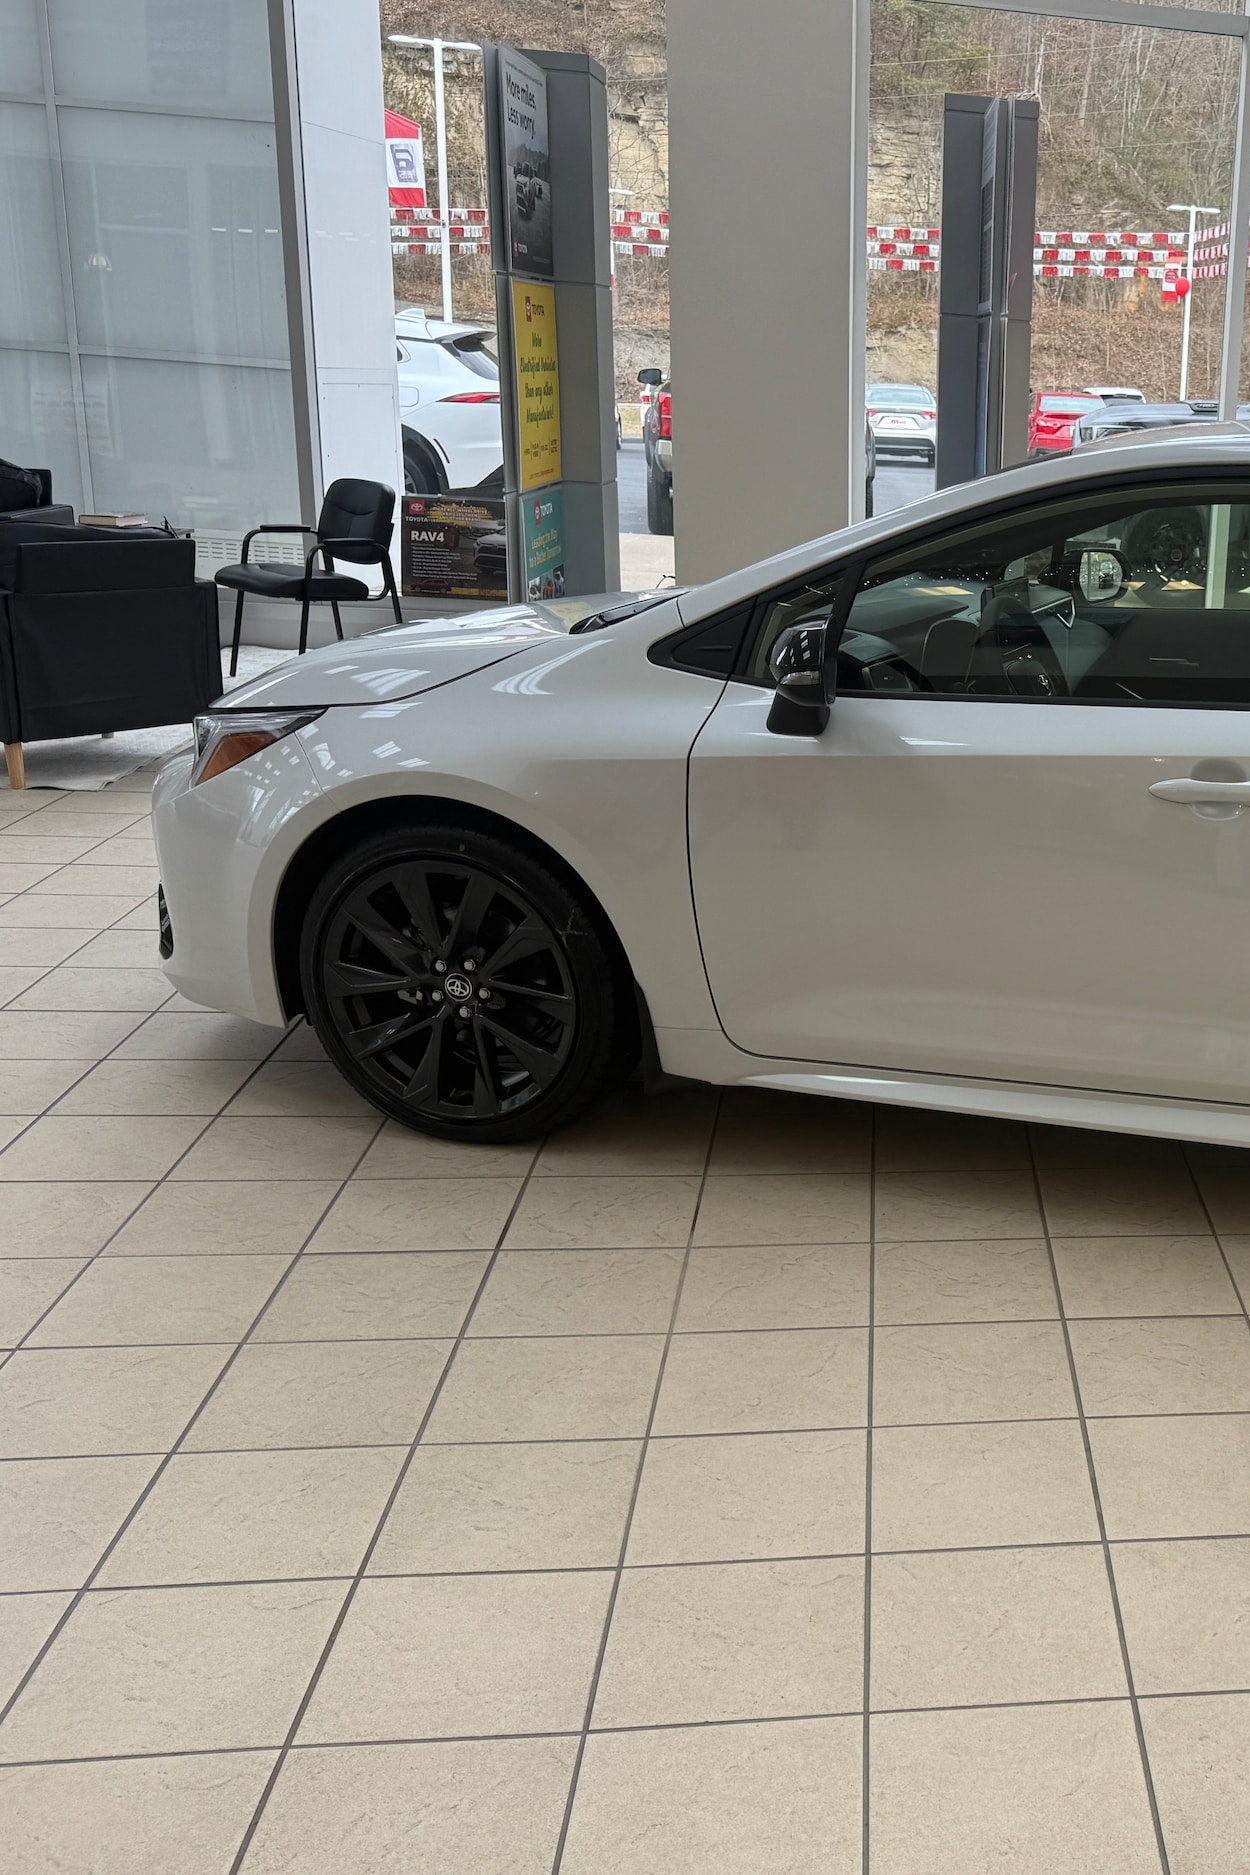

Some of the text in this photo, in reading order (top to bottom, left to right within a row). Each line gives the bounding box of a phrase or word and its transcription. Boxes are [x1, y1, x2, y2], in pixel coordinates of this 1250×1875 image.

[506, 72, 520, 100] More
[521, 84, 537, 110] miles.
[507, 99, 537, 140] Less worry.
[532, 304, 545, 316] TOYOTA
[540, 502, 553, 517] TOYOTA
[411, 530, 445, 543] RAV4
